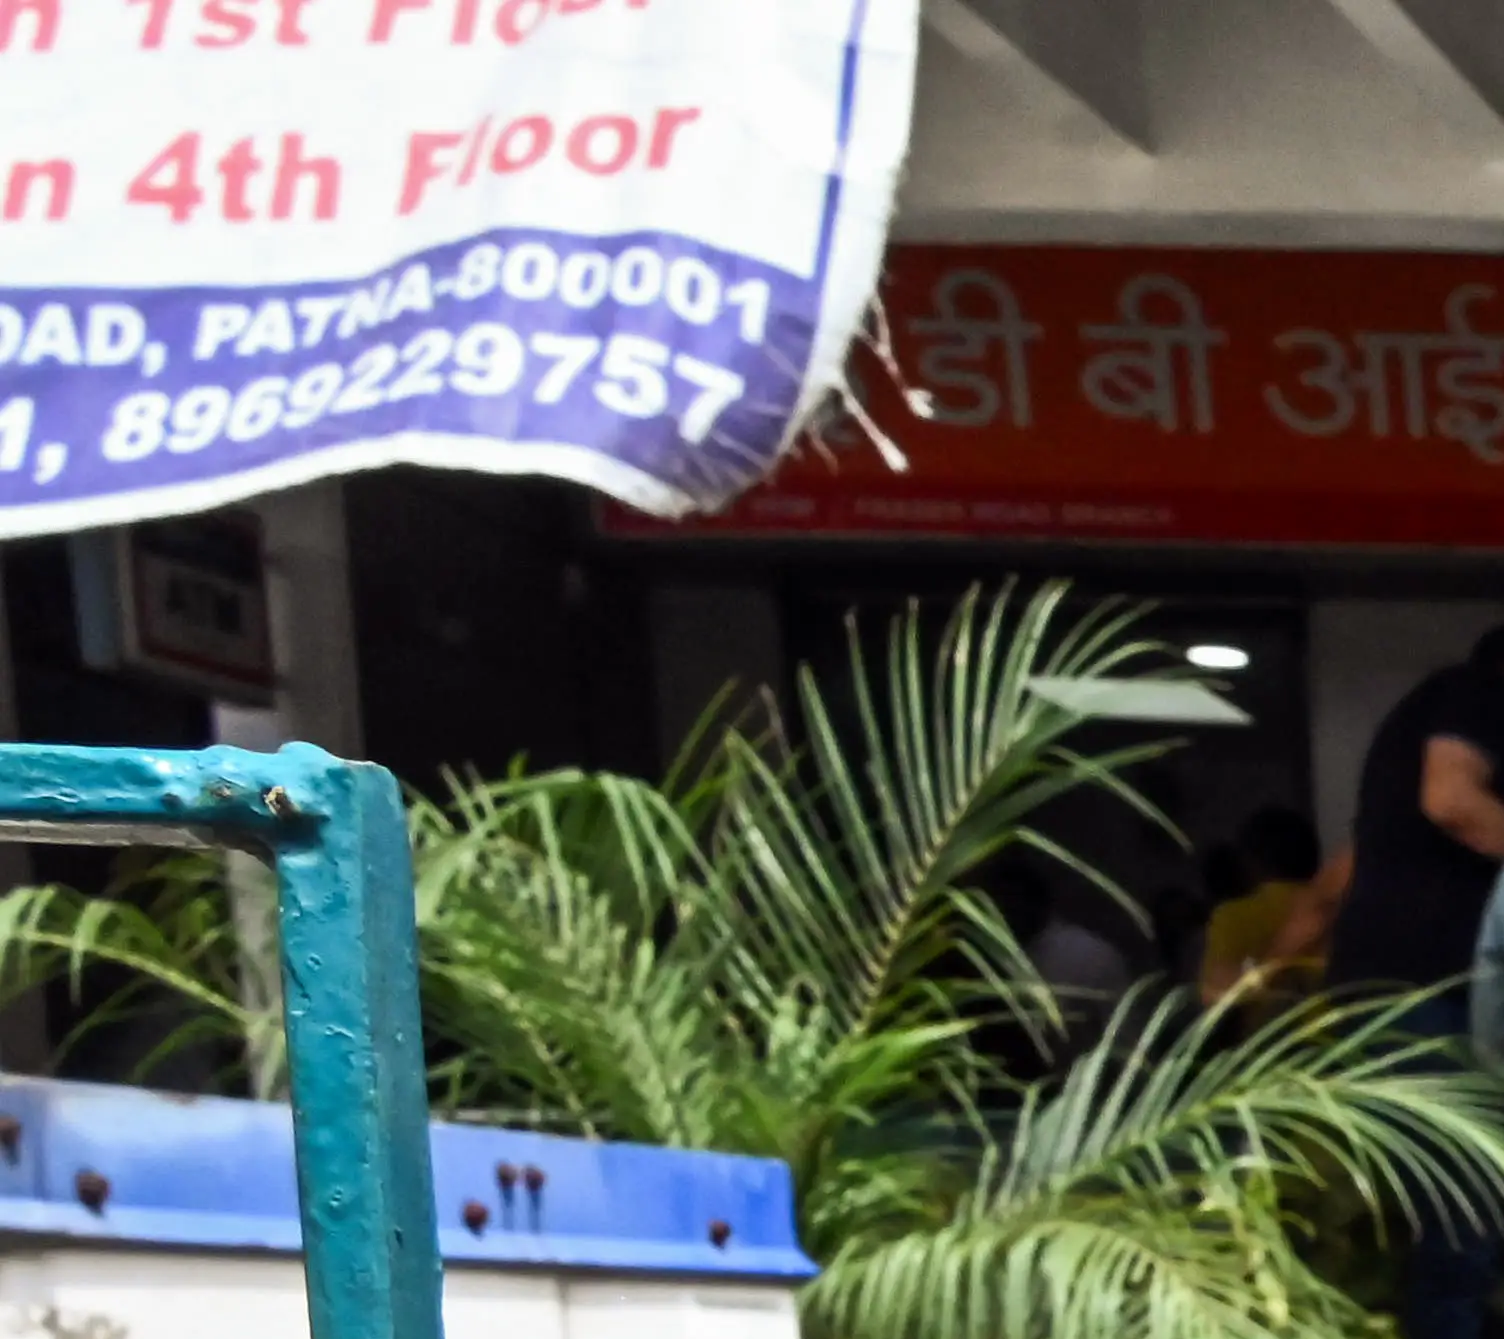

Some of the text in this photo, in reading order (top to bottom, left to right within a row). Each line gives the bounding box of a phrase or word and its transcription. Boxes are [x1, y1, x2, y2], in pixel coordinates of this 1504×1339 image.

[125, 130, 343, 224] 4th
[396, 106, 702, 218] Floor
[0, 242, 771, 377] AD, PATNA-800001
[912, 268, 1046, 431] डी
[1079, 274, 1226, 436] बी
[102, 322, 745, 463] 8969229757
